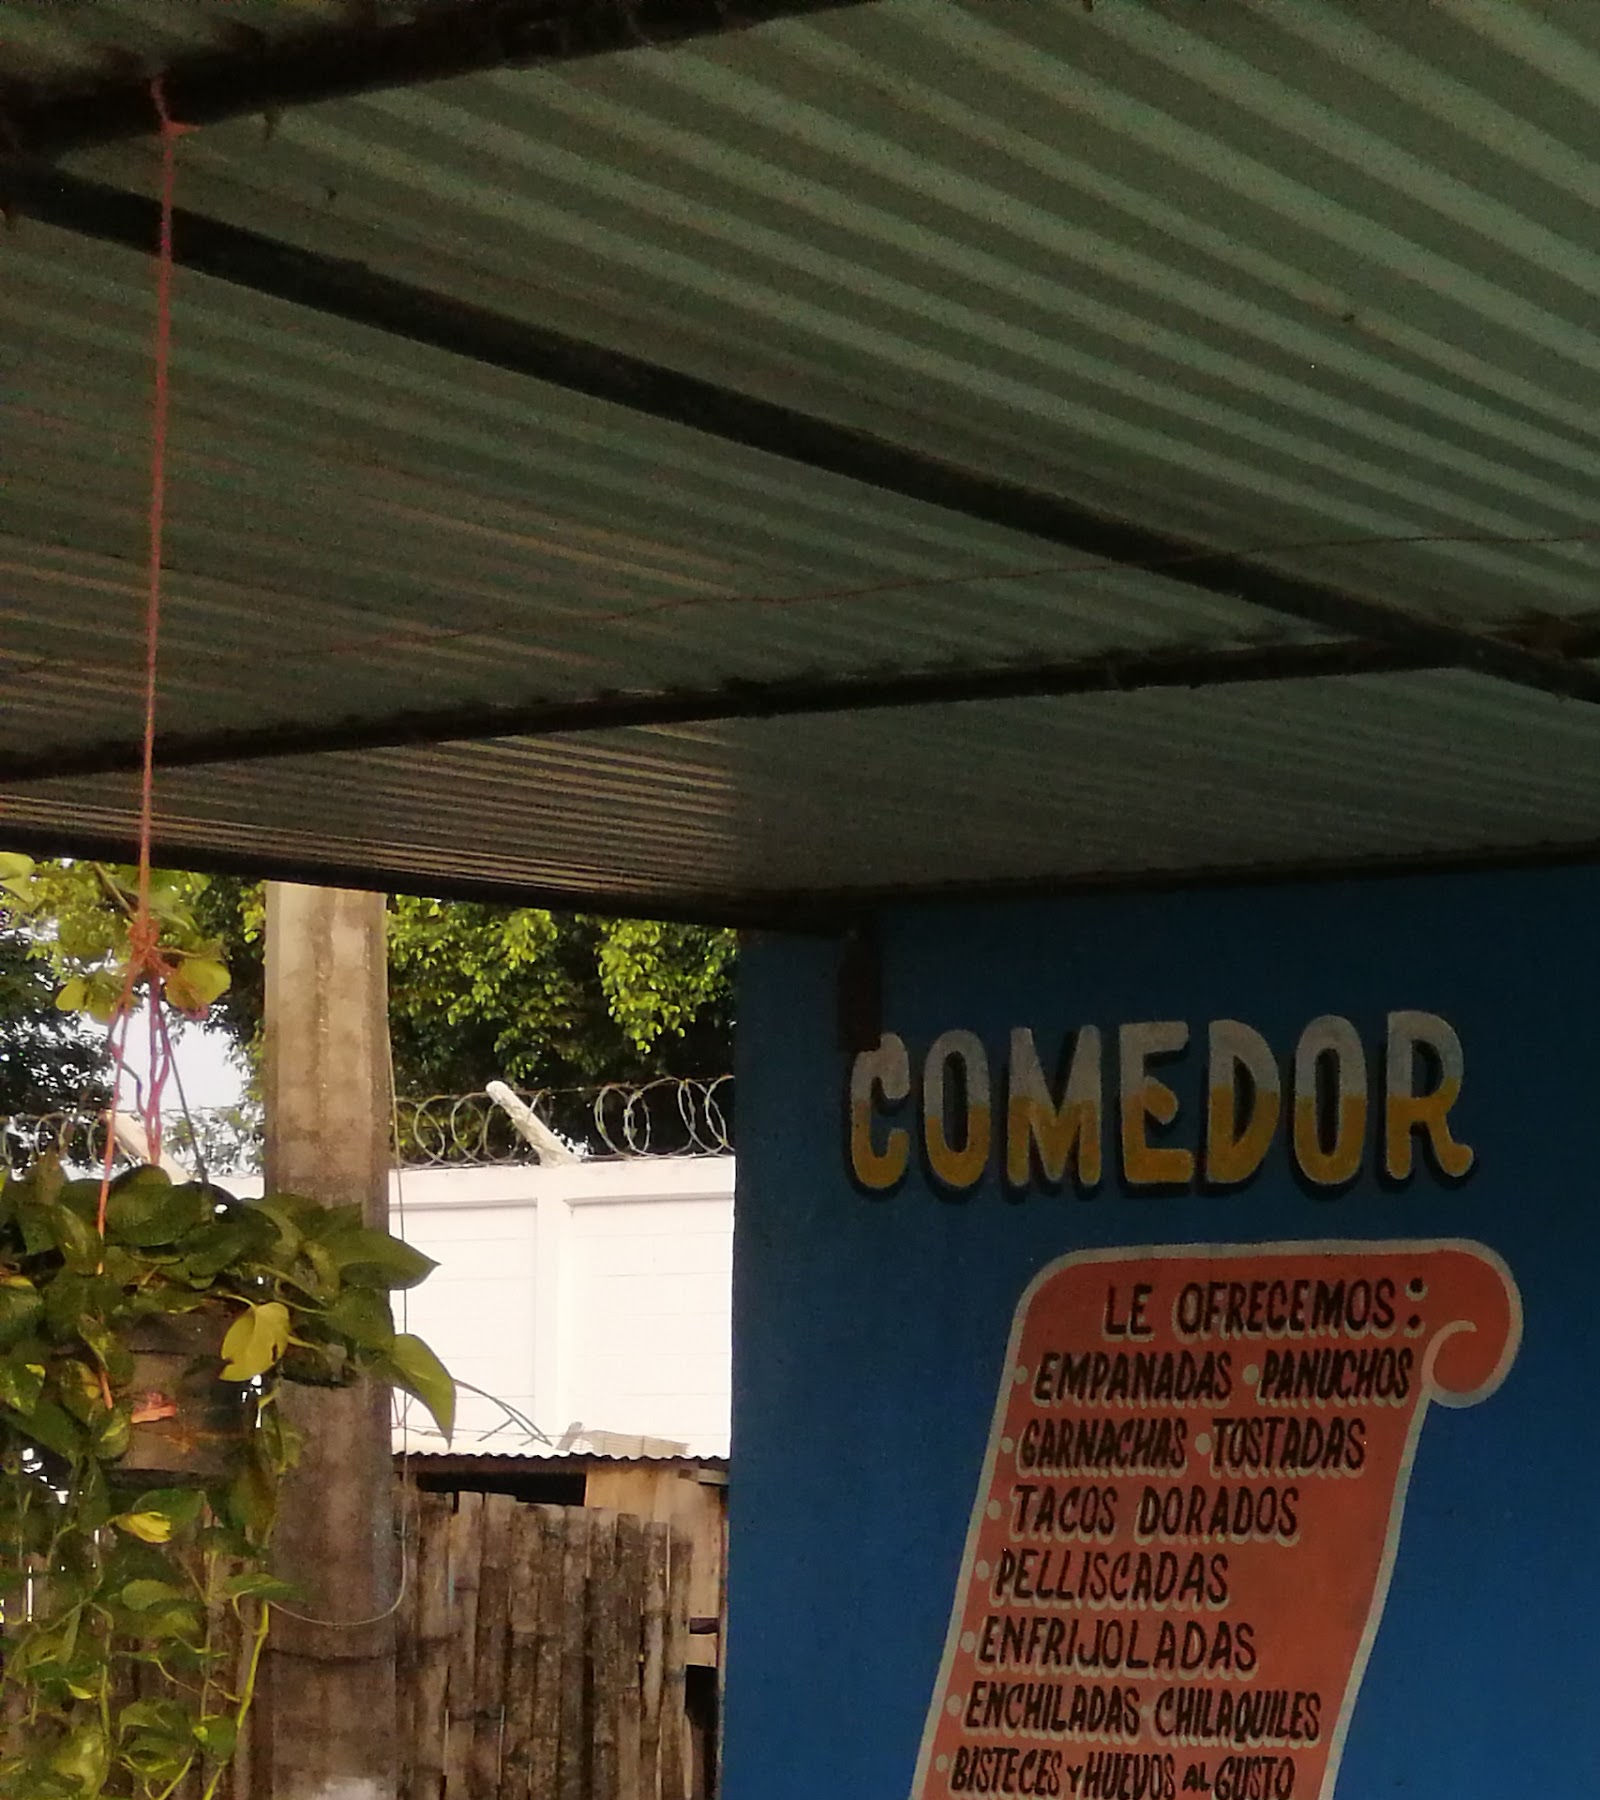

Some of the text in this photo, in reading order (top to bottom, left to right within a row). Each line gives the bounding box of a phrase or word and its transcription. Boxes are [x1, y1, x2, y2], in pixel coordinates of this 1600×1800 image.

[850, 1011, 1475, 1189] COMEDOR
[1104, 1283, 1155, 1337] LE
[1034, 1347, 1413, 1403] EMPANADAS PANUCHOS
[1019, 1416, 1367, 1471] GARNACHAS TOSTADAS
[1012, 1484, 1300, 1537] TACOS DORADOS
[994, 1548, 1230, 1605] PELLISCADAS
[978, 1615, 1259, 1672] ENFRIJOLADAS
[964, 1680, 1322, 1745] ENCHILADAS CHILAQUILES
[950, 1745, 1063, 1796] BISTECES
[1182, 1762, 1212, 1793] AL
